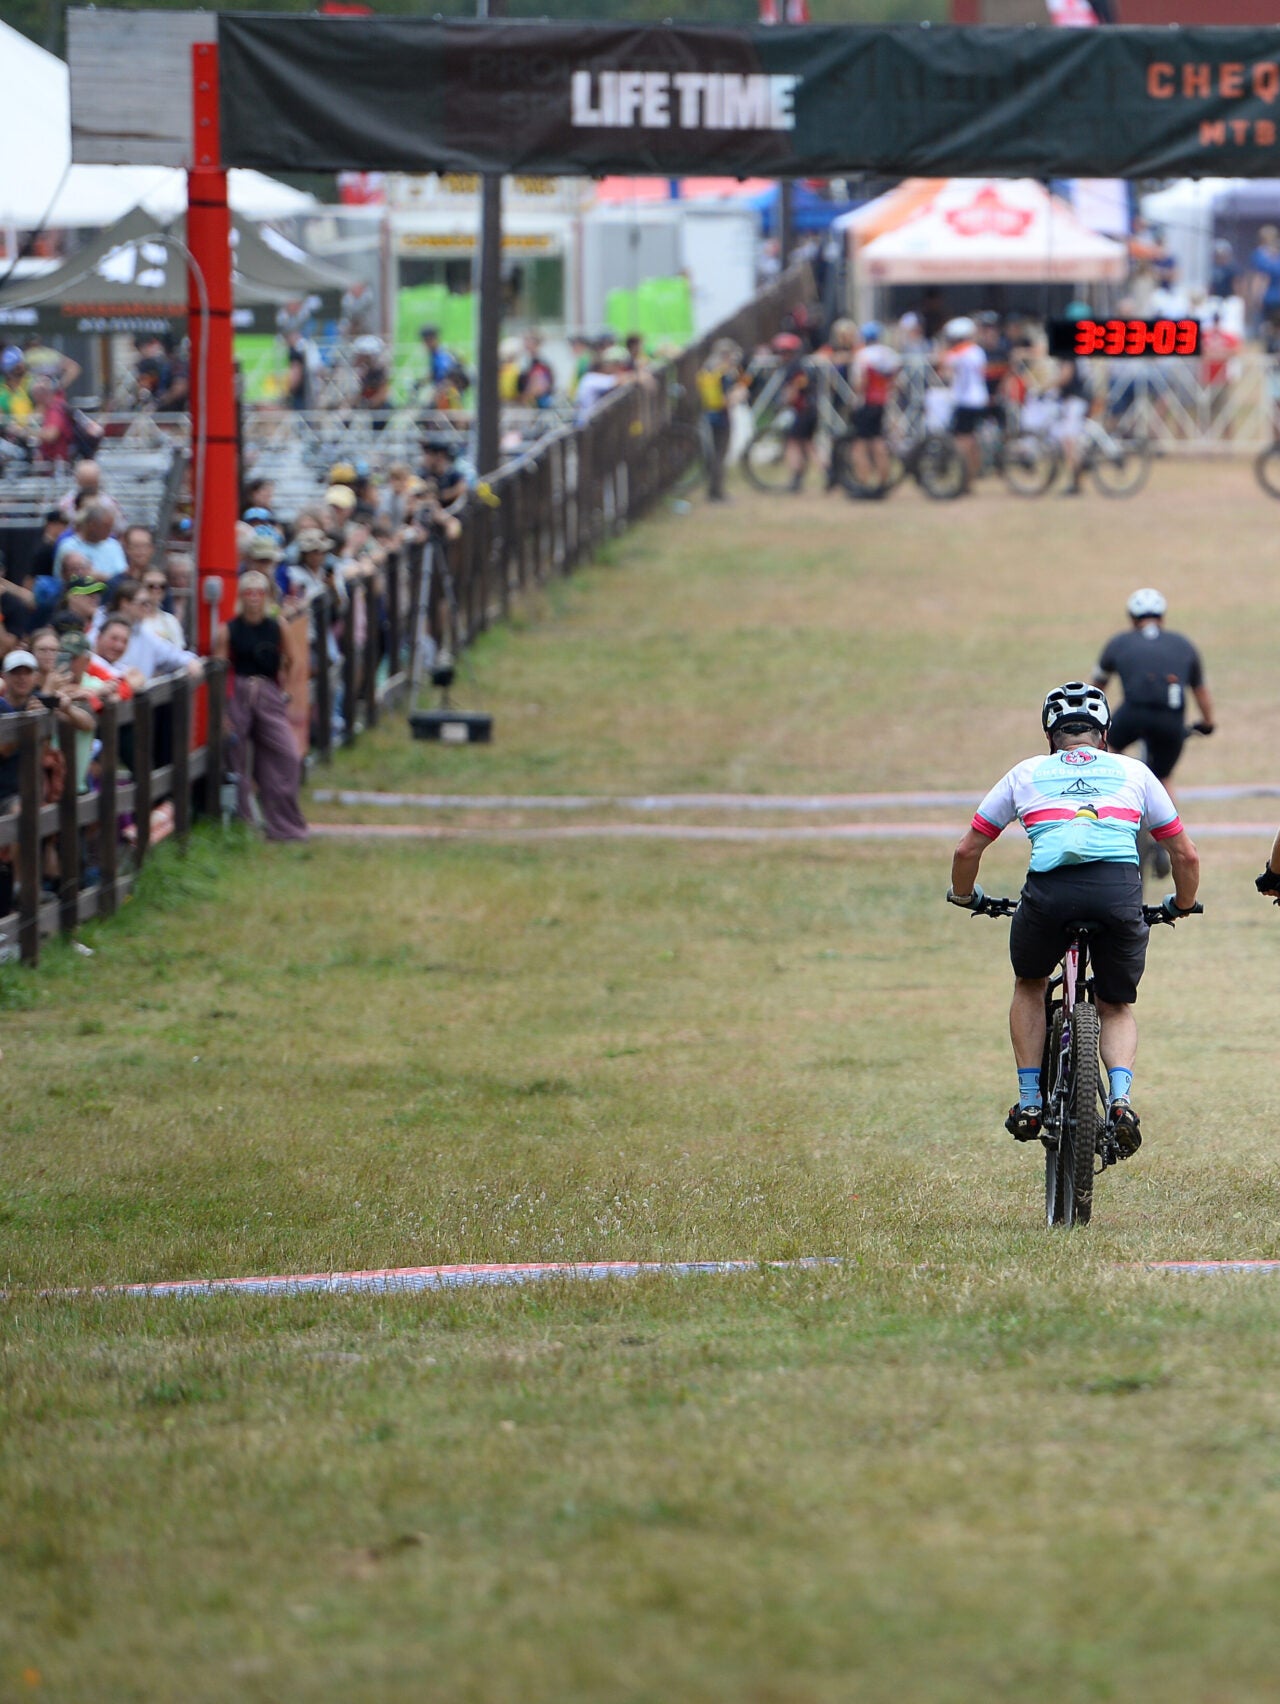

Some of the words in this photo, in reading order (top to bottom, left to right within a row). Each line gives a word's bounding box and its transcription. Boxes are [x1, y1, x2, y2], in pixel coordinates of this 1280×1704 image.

[571, 71, 671, 128] LIFE
[672, 72, 797, 130] TIME
[1199, 119, 1276, 147] MTB
